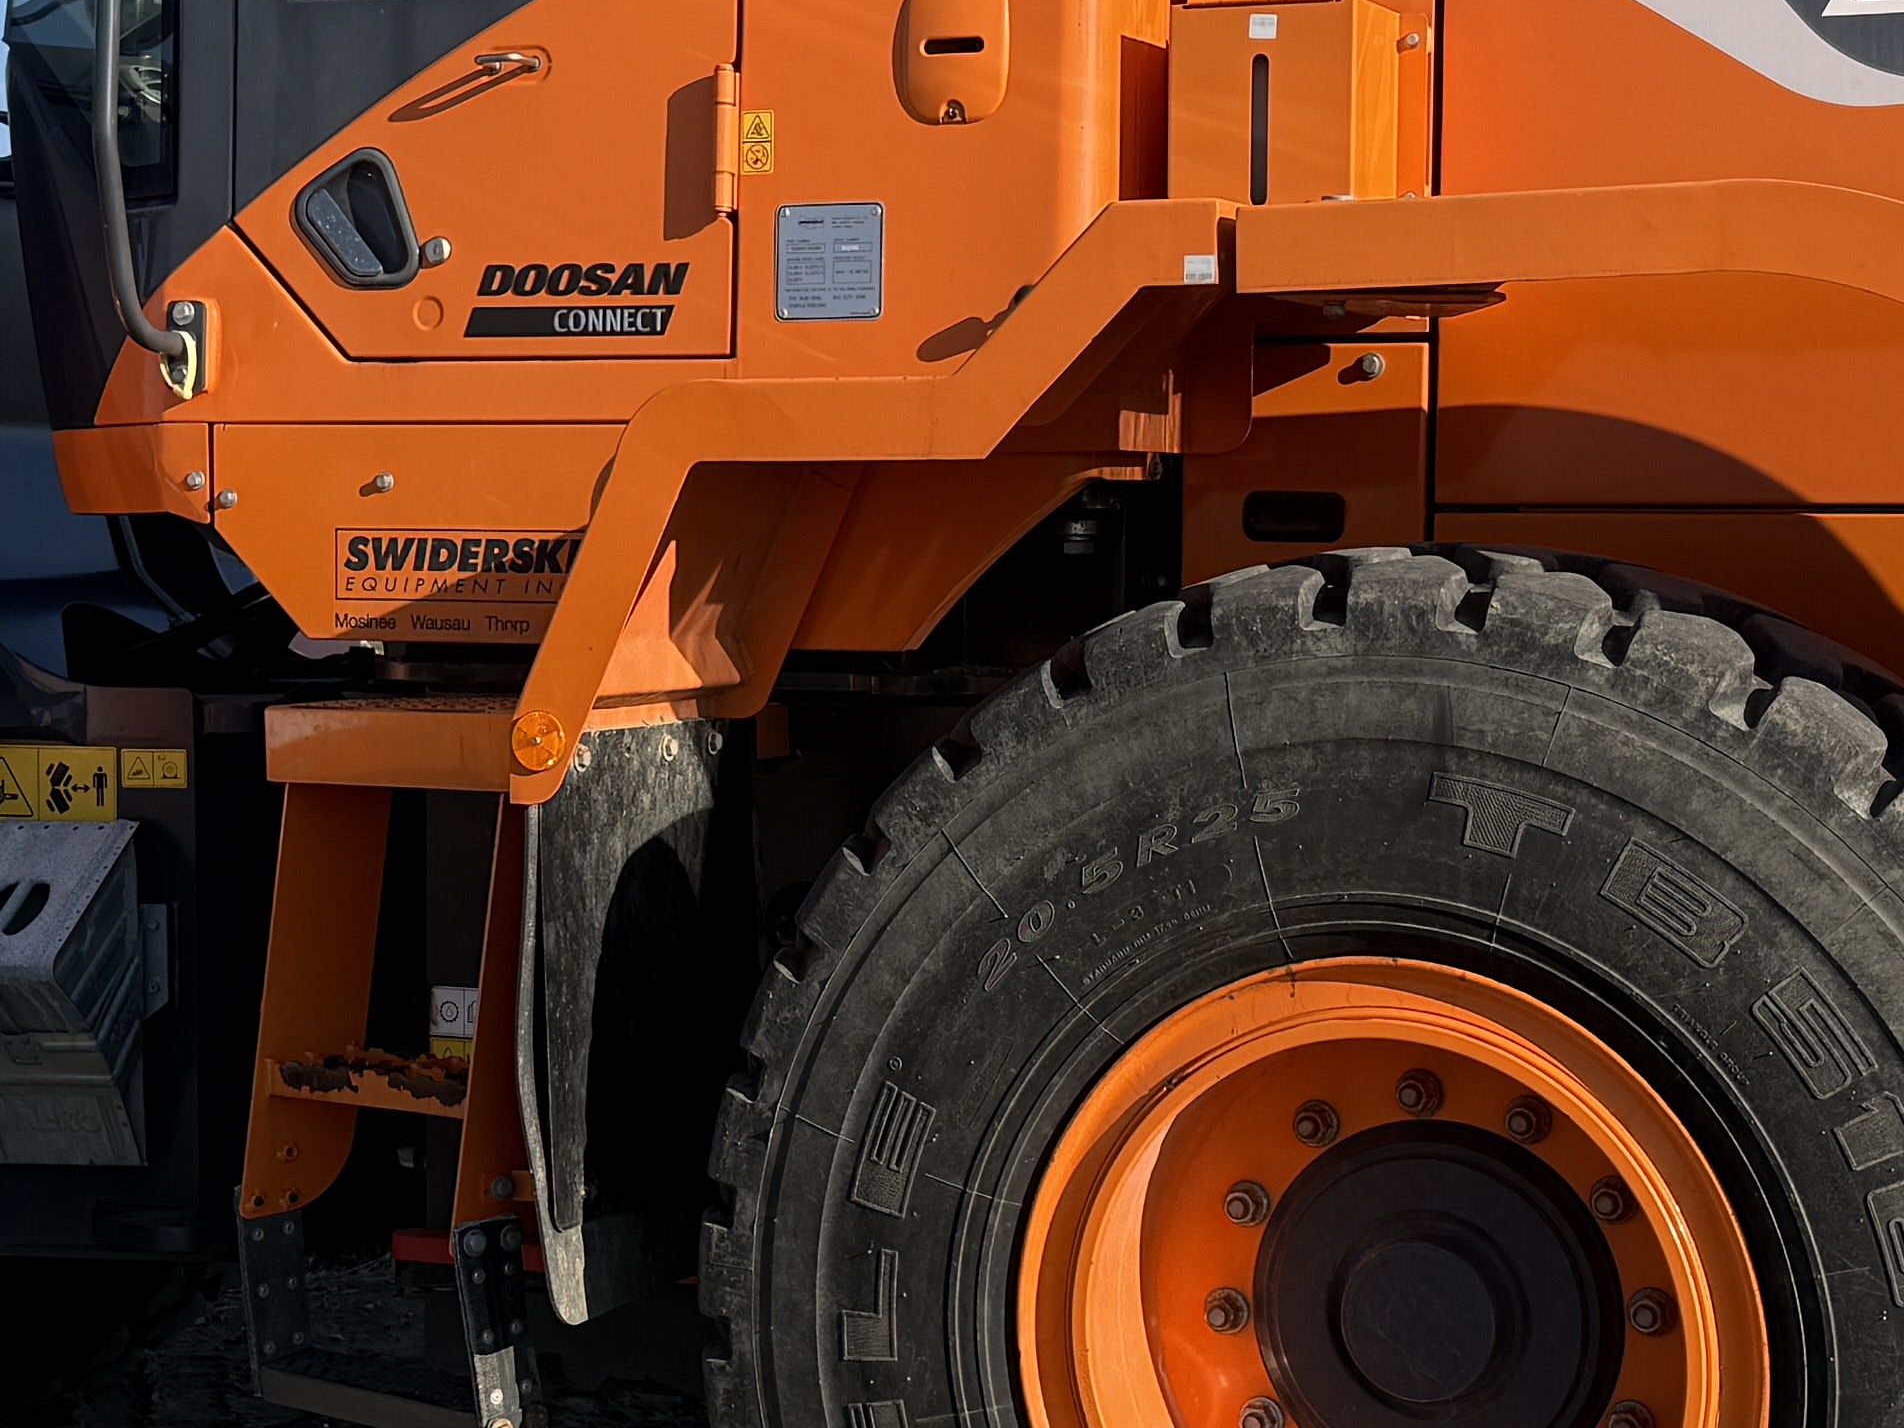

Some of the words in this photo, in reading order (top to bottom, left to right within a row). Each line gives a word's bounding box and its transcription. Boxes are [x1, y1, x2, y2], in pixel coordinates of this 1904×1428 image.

[476, 262, 690, 297] DOOSAN
[553, 308, 667, 333] CONNECT
[345, 576, 506, 594] EQUIPMENT
[335, 613, 396, 630] Mosinee
[411, 614, 471, 632] Wausau
[484, 615, 530, 635] Thorp
[977, 784, 1300, 992] 20.5R25
